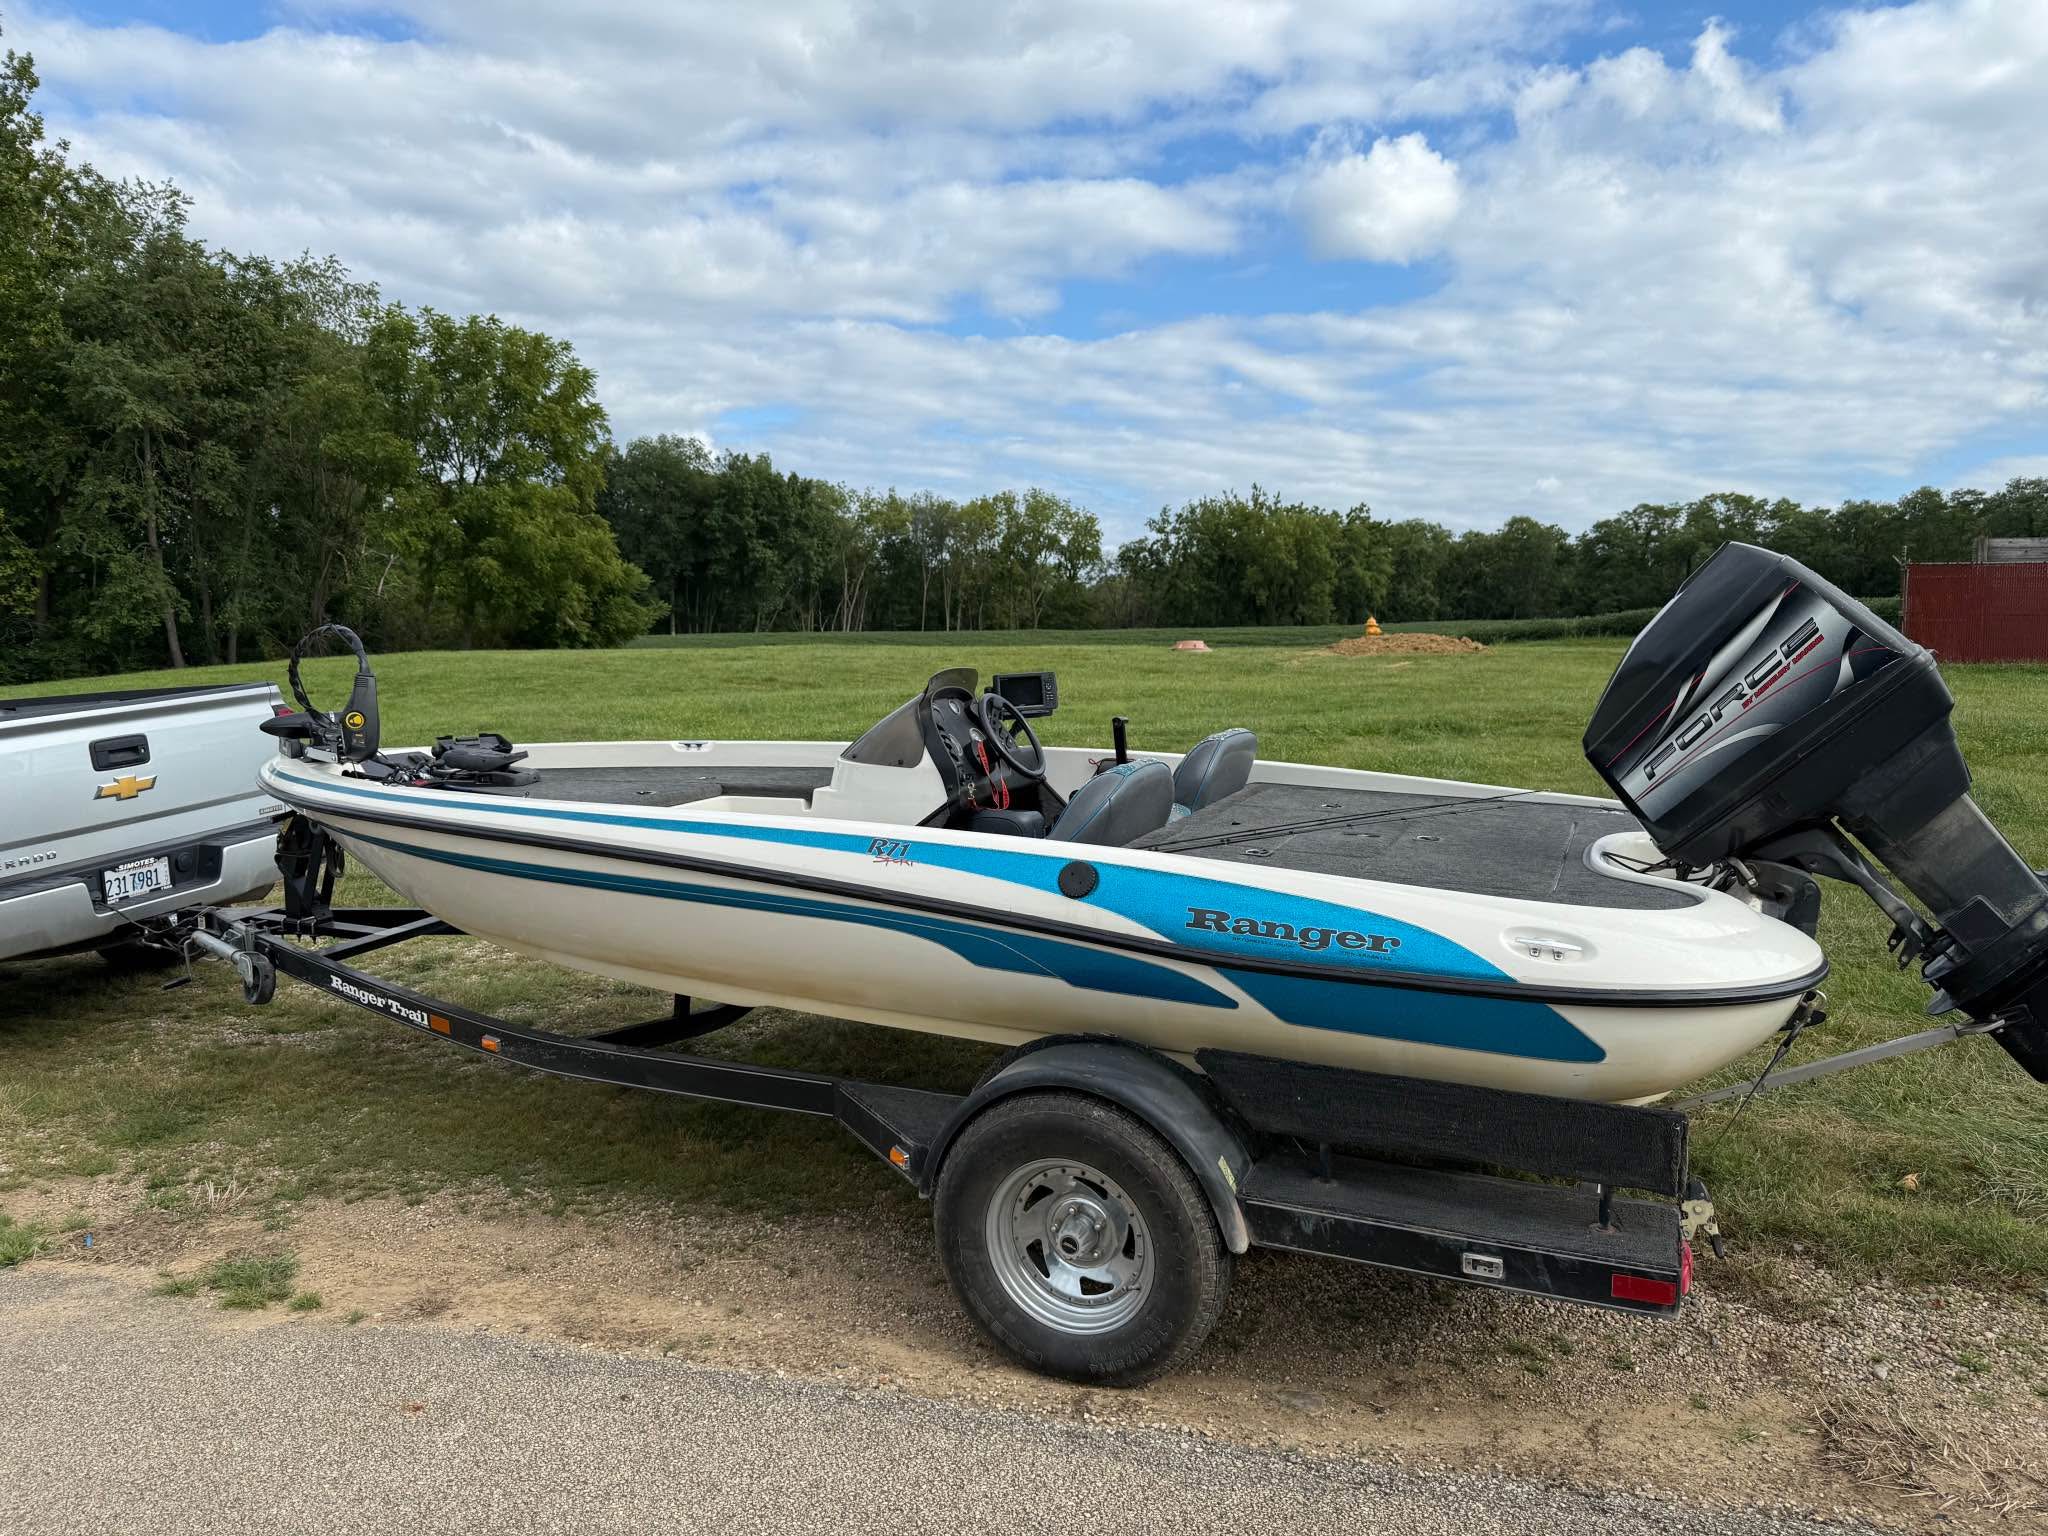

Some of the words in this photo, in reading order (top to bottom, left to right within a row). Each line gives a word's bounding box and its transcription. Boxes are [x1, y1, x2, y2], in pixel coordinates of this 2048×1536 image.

[1643, 616, 1820, 781] FORCE
[118, 857, 155, 871] SIMOTES
[866, 837, 911, 856] R71
[1185, 906, 1401, 953] Ranger
[330, 974, 386, 1008] Ranger
[387, 998, 430, 1026] Trail
